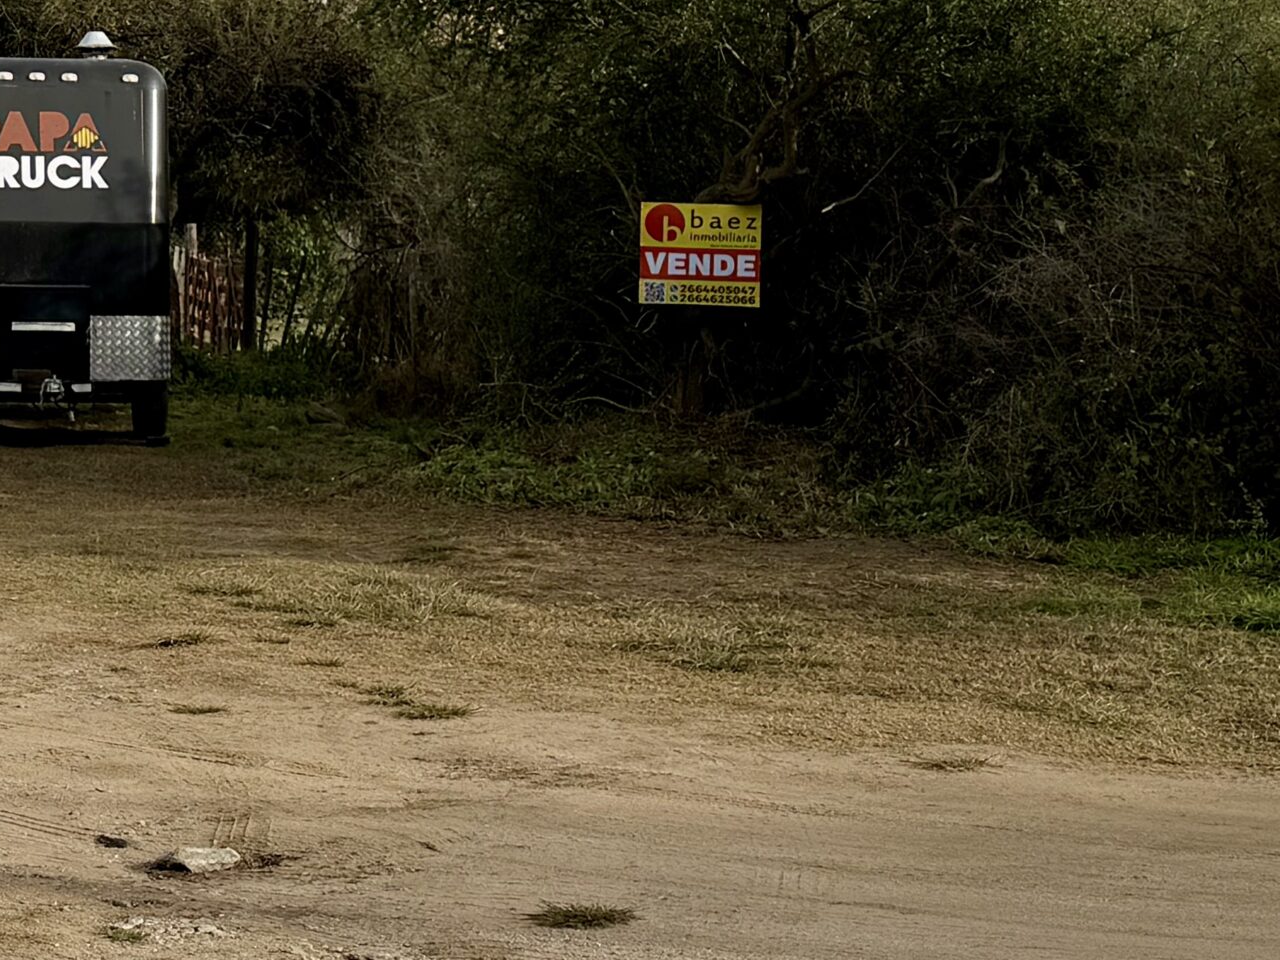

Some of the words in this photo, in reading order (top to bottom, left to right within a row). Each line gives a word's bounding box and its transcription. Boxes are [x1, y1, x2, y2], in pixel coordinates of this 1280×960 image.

[690, 209, 757, 230] baez
[689, 231, 757, 243] inmobiliaria
[644, 251, 756, 277] VENDE
[679, 284, 756, 295] 2664405047
